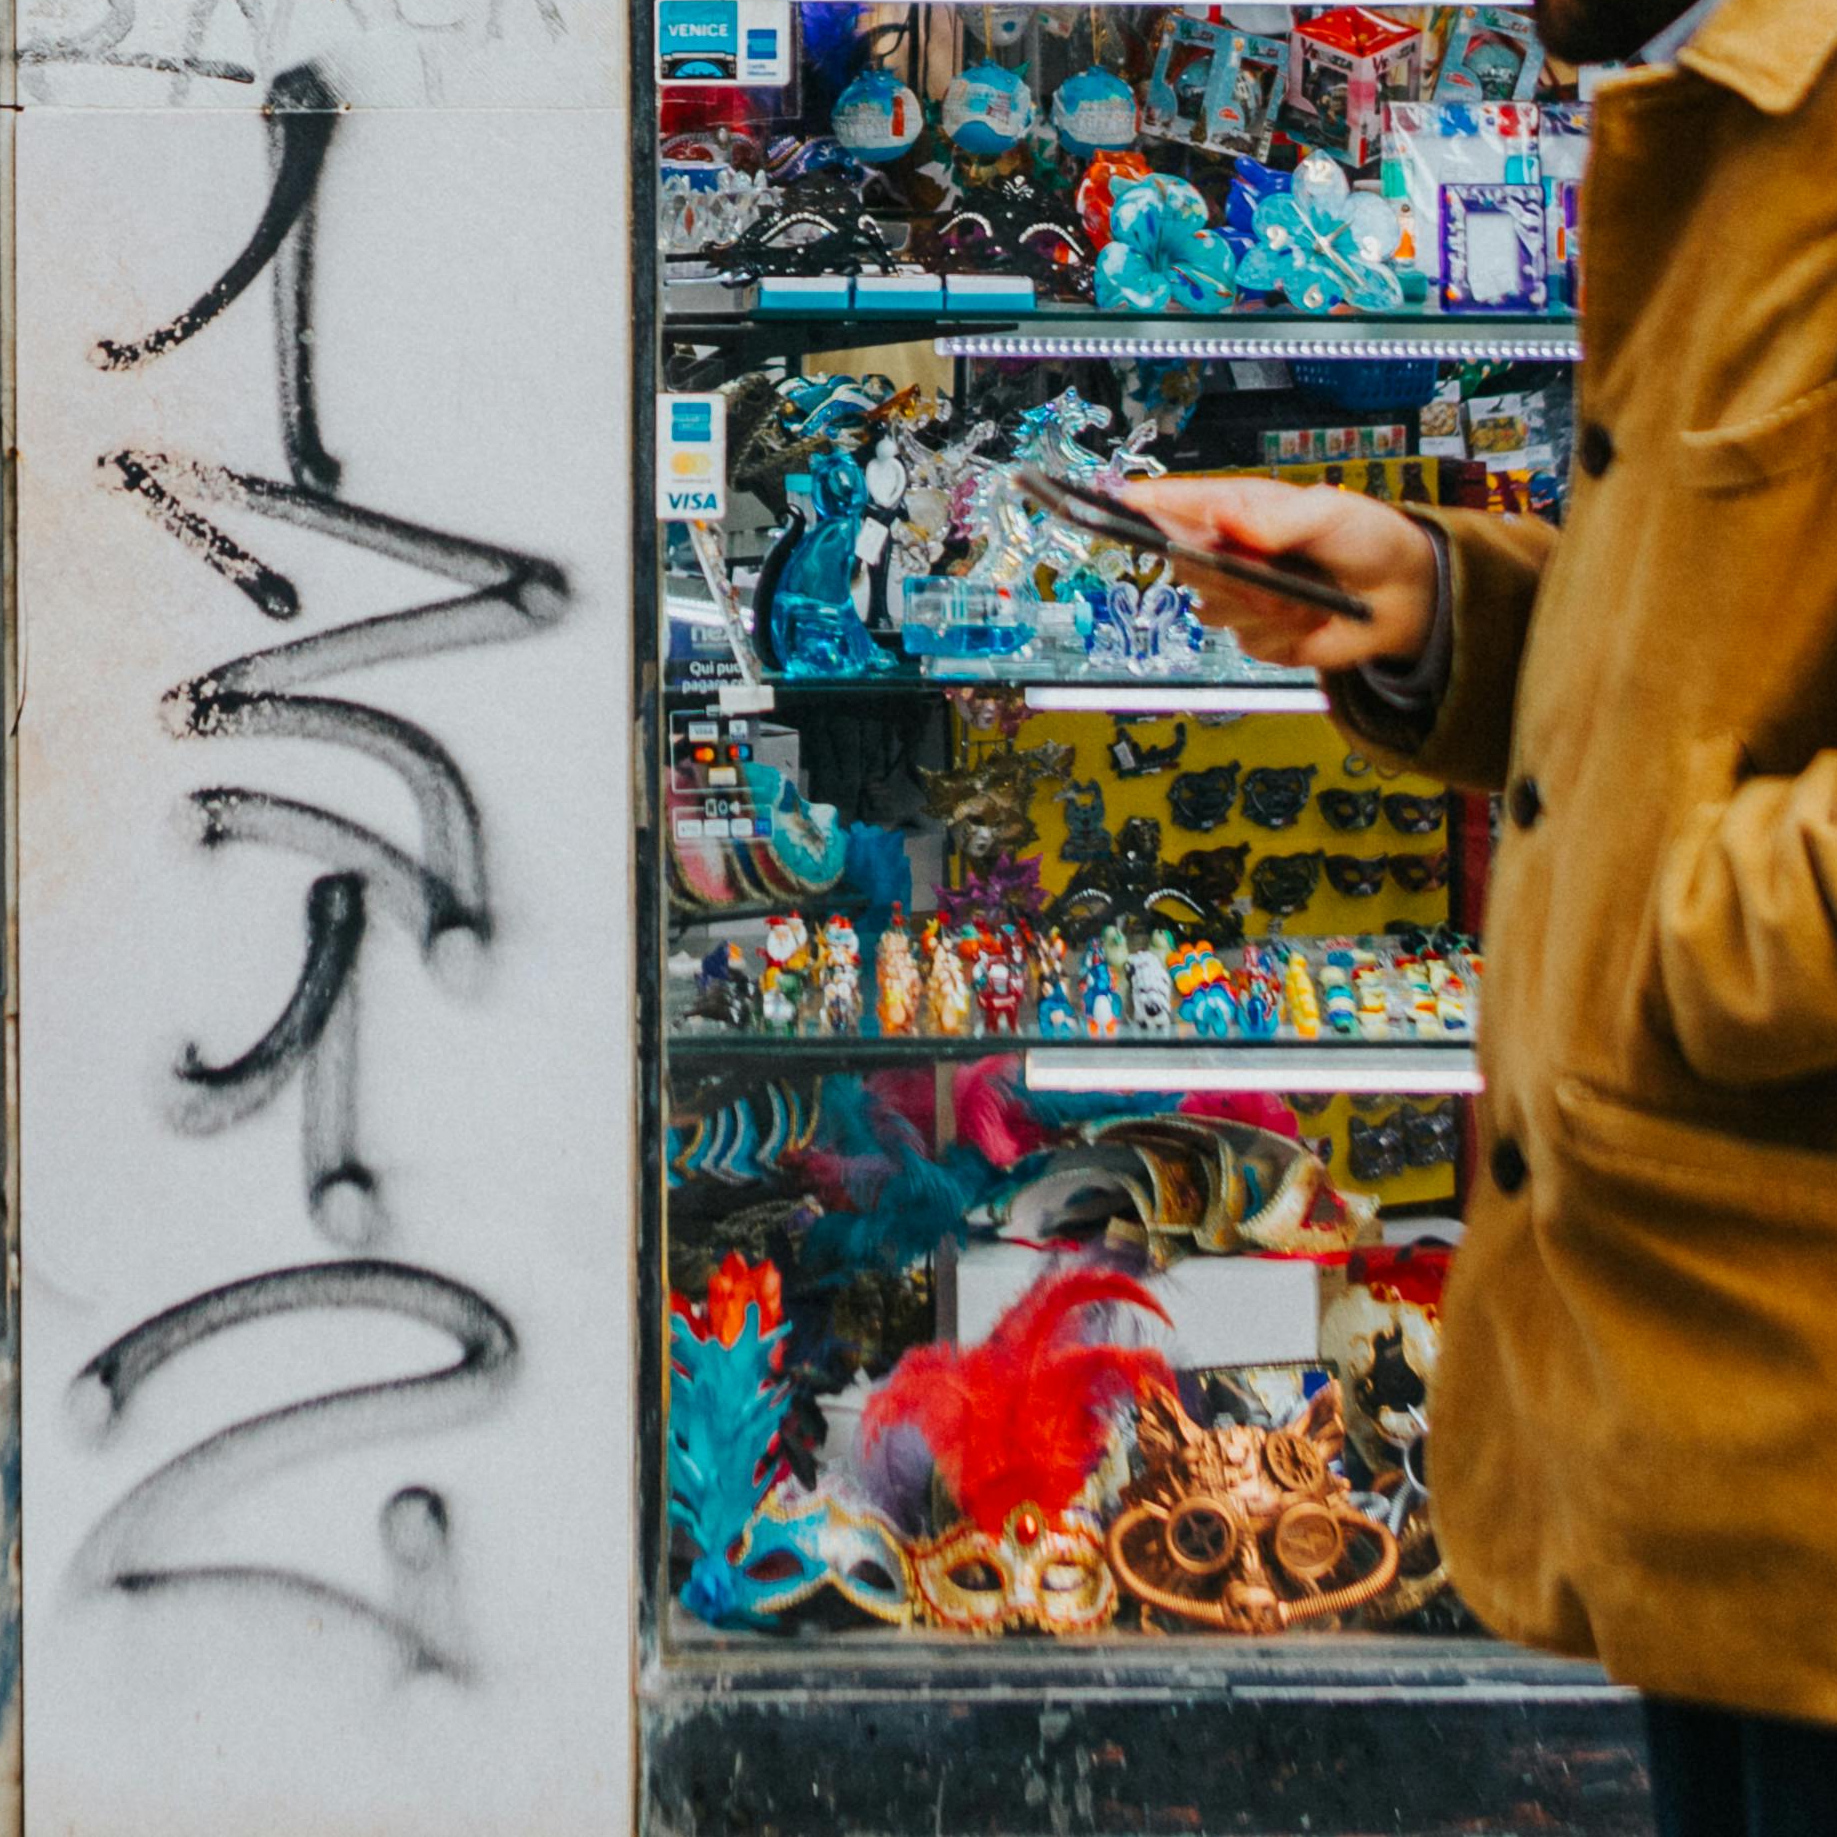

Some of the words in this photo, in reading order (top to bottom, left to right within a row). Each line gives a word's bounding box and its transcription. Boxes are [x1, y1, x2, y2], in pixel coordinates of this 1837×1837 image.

[668, 23, 730, 38] VENICE
[669, 492, 718, 510] VISA
[689, 661, 715, 677] Qui
